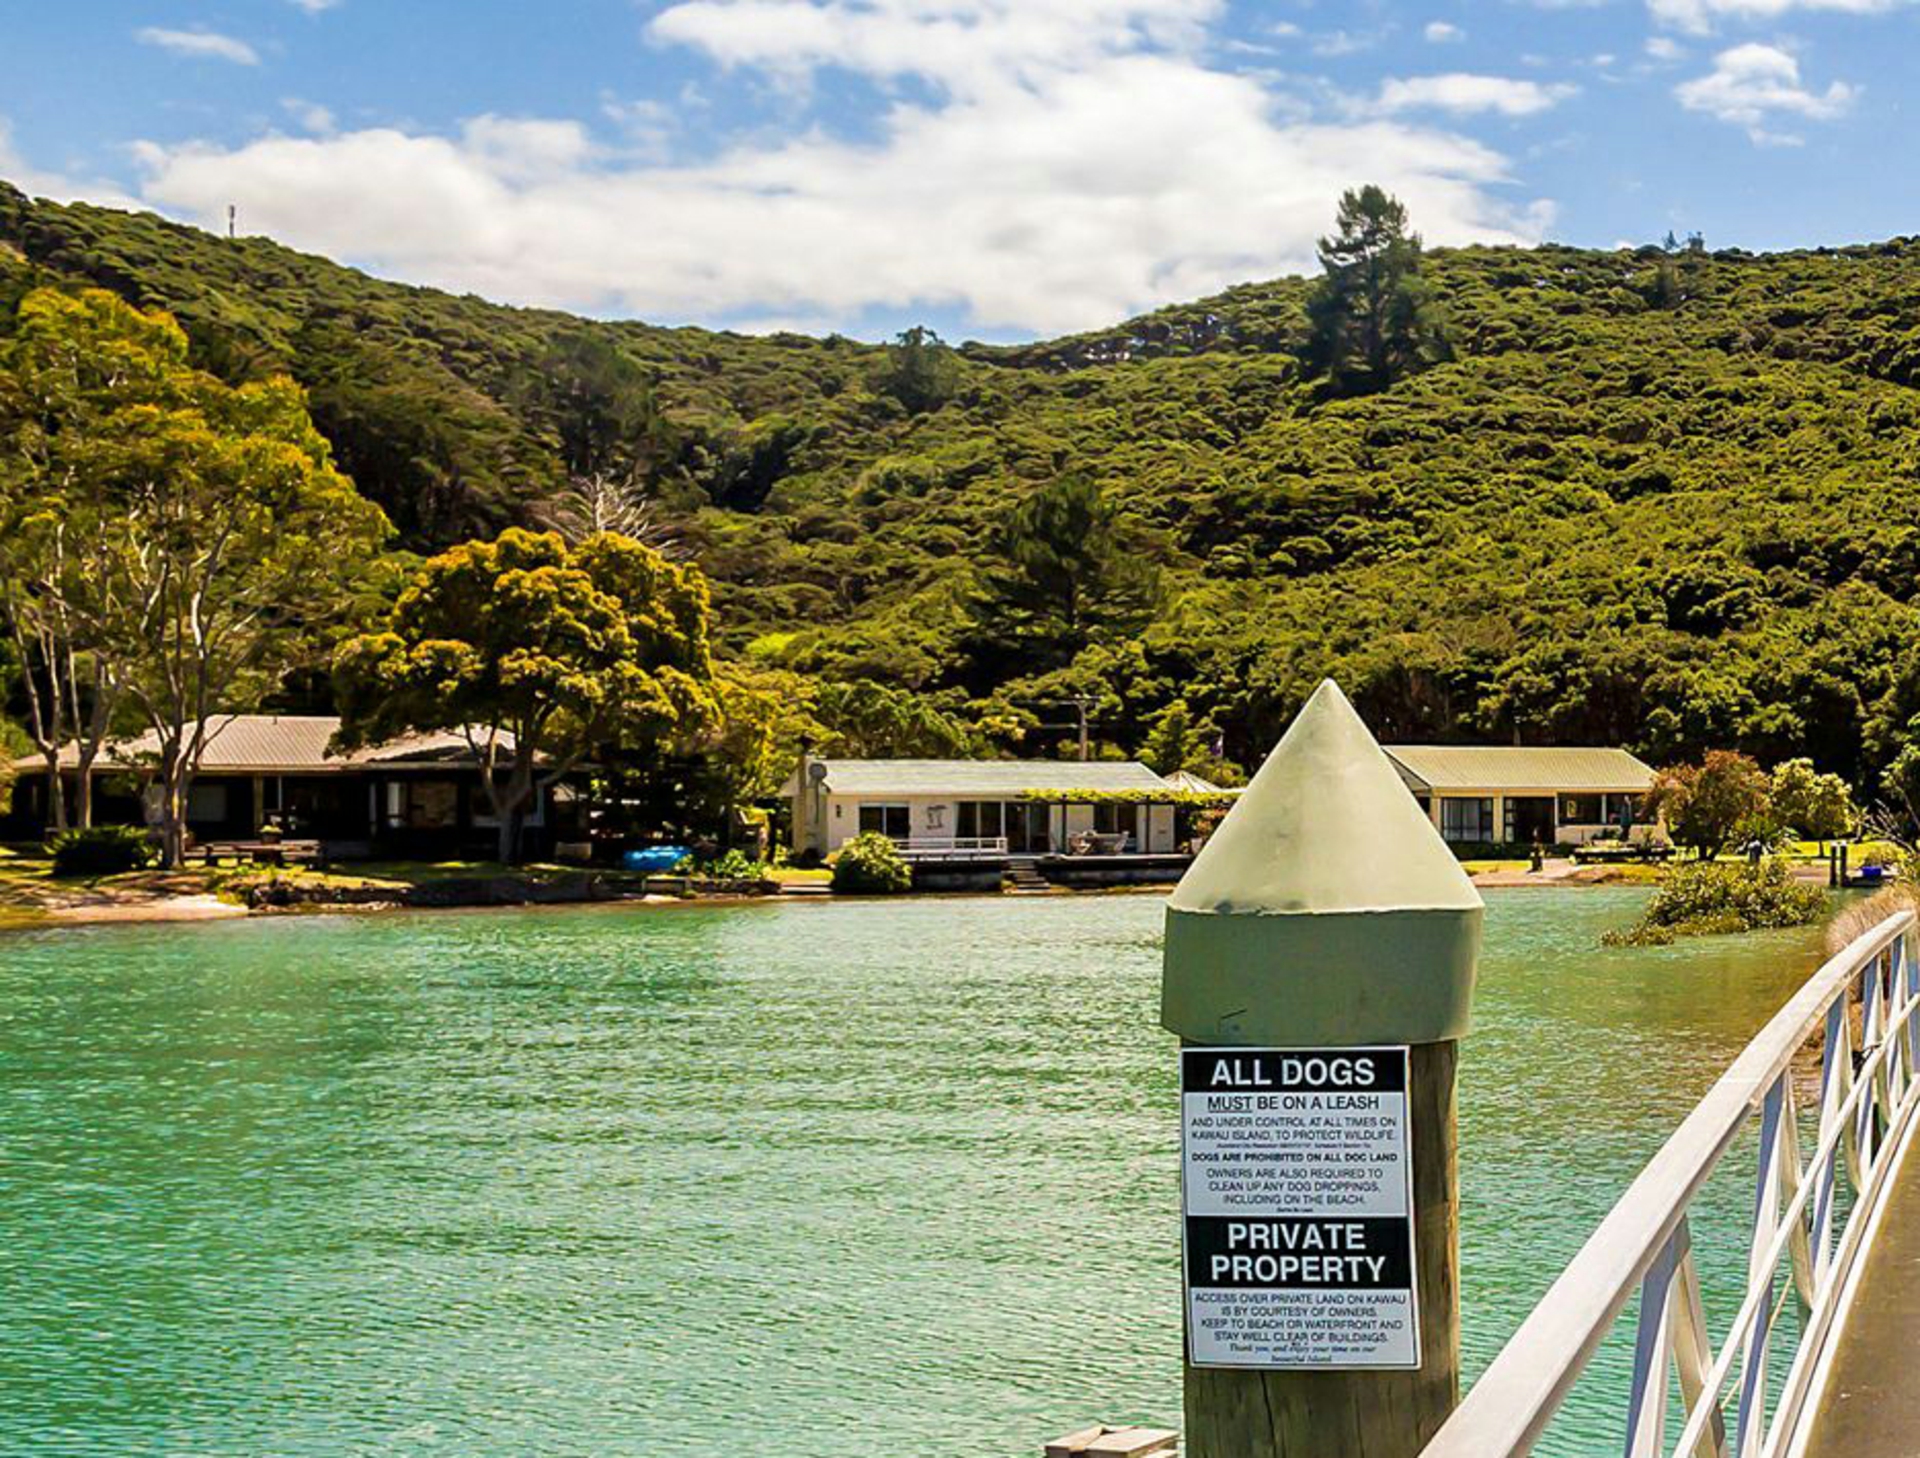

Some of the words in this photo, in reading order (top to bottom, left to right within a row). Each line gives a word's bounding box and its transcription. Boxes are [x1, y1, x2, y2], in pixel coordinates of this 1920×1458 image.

[1211, 1058, 1272, 1086] ALL
[1281, 1058, 1375, 1086] DOGS
[1207, 1096, 1252, 1111] MUST
[1257, 1096, 1278, 1110] BE
[1282, 1096, 1306, 1110] ON
[1310, 1096, 1322, 1110] A
[1326, 1096, 1379, 1110] LEASH
[1191, 1116, 1214, 1127] AND
[1216, 1116, 1252, 1127] UNDER
[1255, 1116, 1305, 1127] CONTROL
[1309, 1116, 1322, 1127] AT
[1323, 1116, 1342, 1127] ALL
[1344, 1116, 1377, 1127] TIMES
[1380, 1116, 1397, 1127] ON
[1191, 1130, 1229, 1141] KAWAU
[1275, 1130, 1290, 1141] TO
[1292, 1130, 1342, 1141] PROTECT
[1191, 1152, 1219, 1163] DOGS
[1222, 1152, 1242, 1162] ARE
[1243, 1152, 1304, 1162] PROHIBITED
[1306, 1152, 1321, 1163] ON
[1323, 1152, 1342, 1162] ALL
[1345, 1152, 1366, 1163] DOC
[1369, 1152, 1398, 1162] LAND
[1206, 1168, 1253, 1178] OWNERS
[1255, 1168, 1276, 1178] ARE
[1279, 1168, 1307, 1178] ALSO
[1310, 1168, 1365, 1179] REQUIRED
[1367, 1168, 1383, 1178] TO
[1208, 1181, 1243, 1191] CLEAN
[1246, 1181, 1261, 1191] UP
[1263, 1181, 1284, 1191] ANY
[1287, 1181, 1311, 1192] DOG
[1223, 1194, 1282, 1204] INCLUDING
[1284, 1194, 1300, 1204] ON
[1303, 1194, 1323, 1204] THE
[1228, 1223, 1366, 1250] PRIVATE
[1211, 1254, 1386, 1282] PROPERTY
[1195, 1293, 1237, 1303] ACCESS
[1240, 1293, 1268, 1304] OVER
[1271, 1293, 1313, 1304] PRIVATE
[1316, 1294, 1344, 1304] LAND
[1347, 1294, 1363, 1304] ON
[1367, 1294, 1406, 1304] KAWAU
[1221, 1306, 1231, 1316] IS
[1234, 1306, 1247, 1316] BY
[1250, 1306, 1308, 1317] COURTESY
[1311, 1306, 1325, 1317] OF
[1201, 1318, 1227, 1329] KEEP
[1231, 1319, 1245, 1329] TO
[1247, 1319, 1284, 1329] BEACH
[1286, 1319, 1303, 1329] OR
[1305, 1320, 1377, 1329] WATERFRONT
[1379, 1320, 1403, 1330] AND
[1214, 1331, 1239, 1341] STAY
[1241, 1332, 1271, 1342] WELL
[1273, 1332, 1308, 1342] CLEAR
[1310, 1332, 1325, 1342] OF
